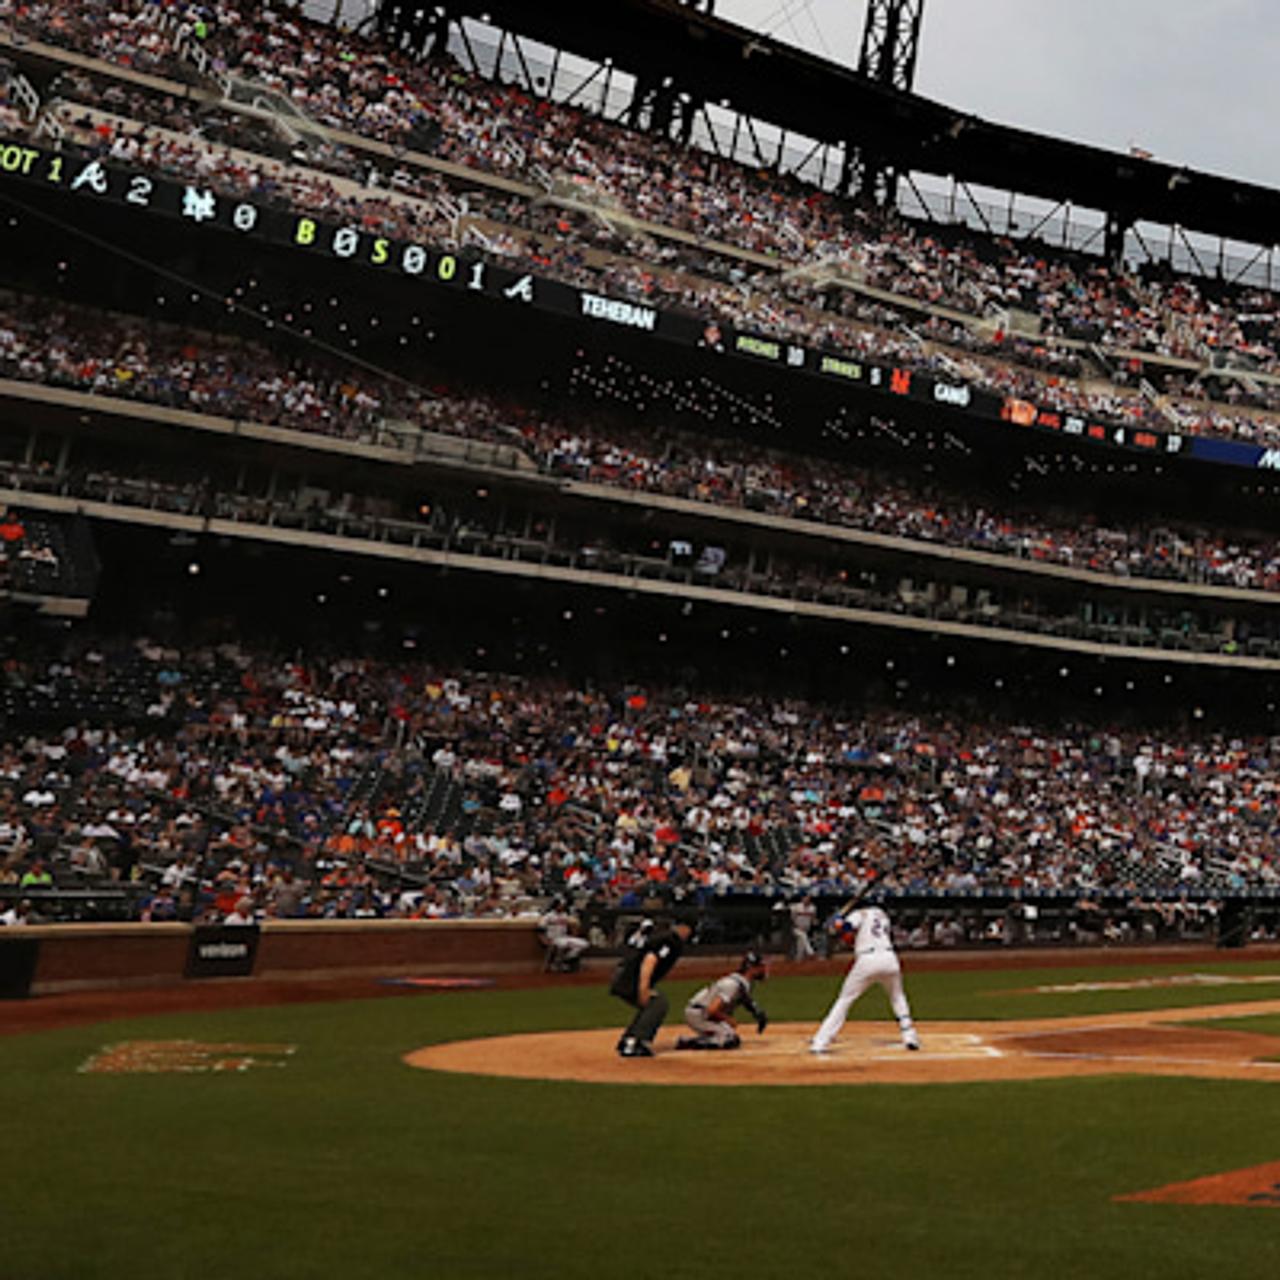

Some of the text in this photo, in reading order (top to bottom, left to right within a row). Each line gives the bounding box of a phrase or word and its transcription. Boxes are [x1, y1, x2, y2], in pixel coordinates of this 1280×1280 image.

[0, 144, 63, 181] OT 1
[127, 176, 152, 205] 2
[233, 204, 257, 230] 0
[296, 219, 315, 244] B
[371, 239, 389, 263] S
[468, 262, 485, 290] 1
[580, 293, 656, 331] TEHERAN
